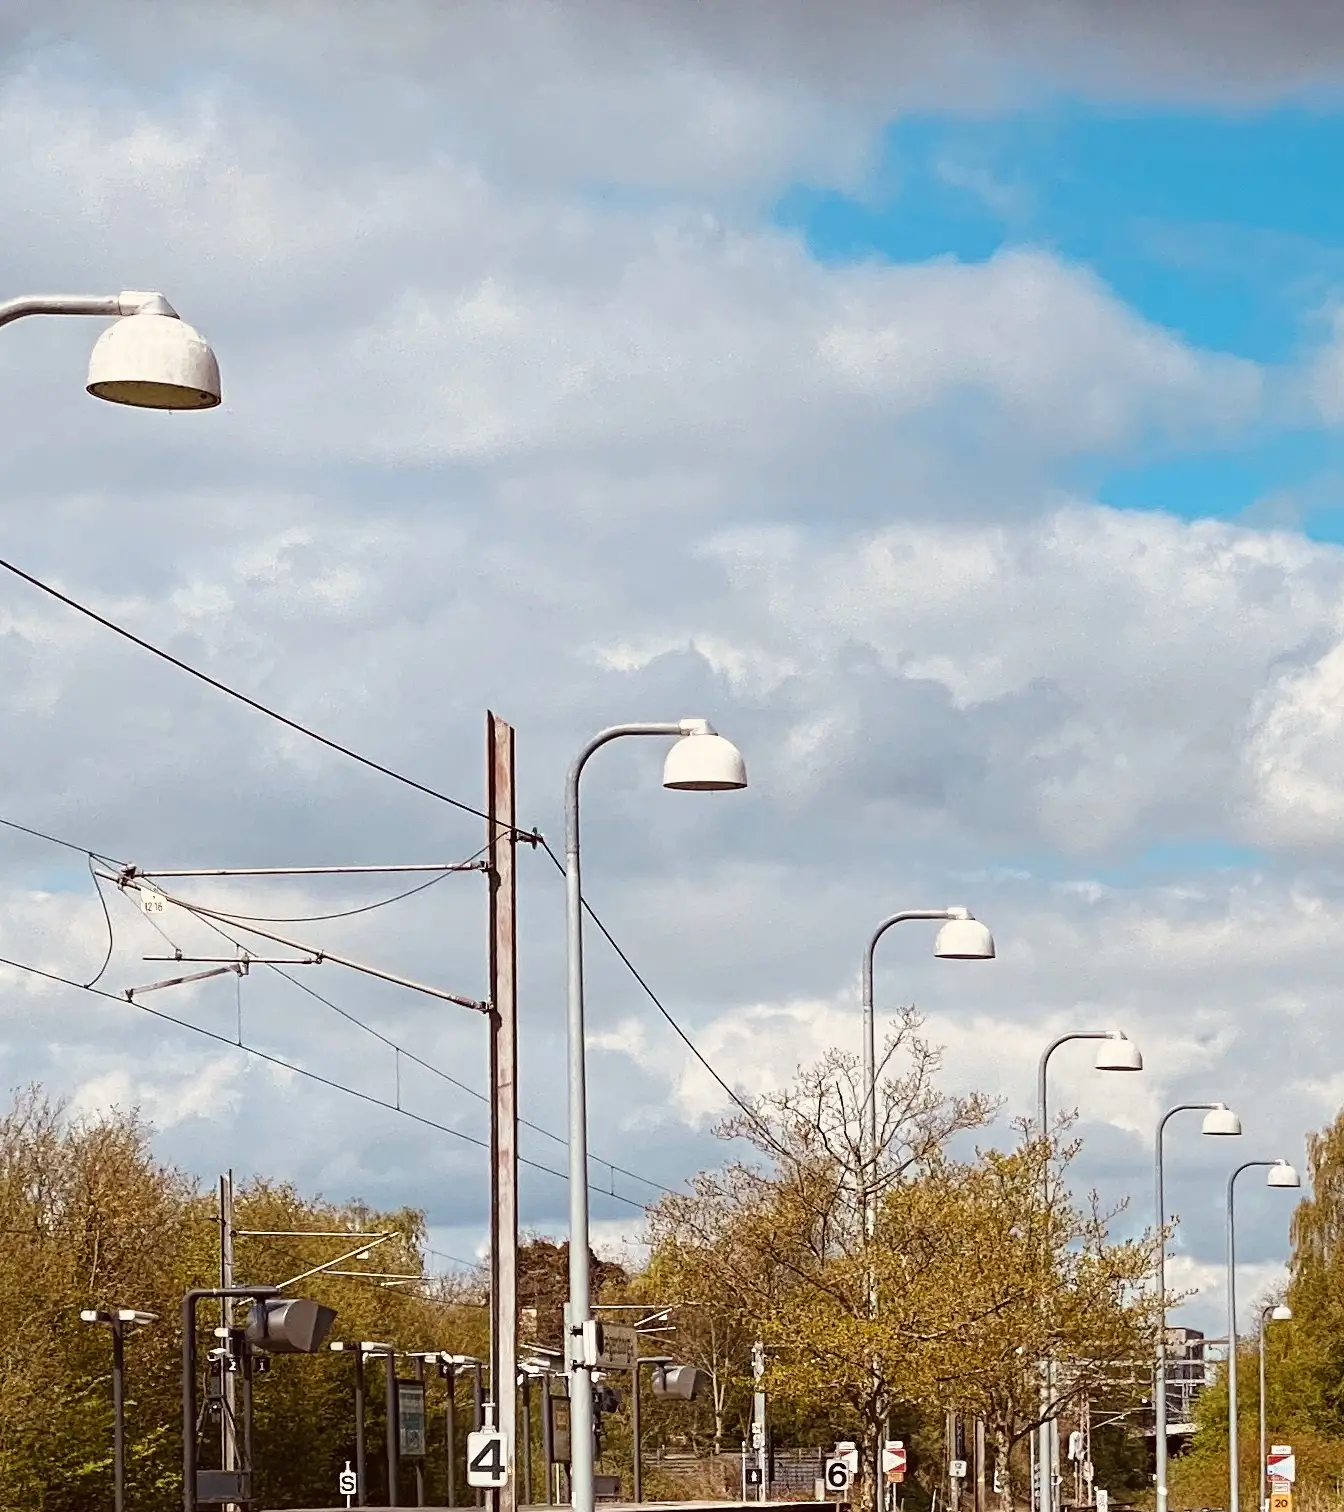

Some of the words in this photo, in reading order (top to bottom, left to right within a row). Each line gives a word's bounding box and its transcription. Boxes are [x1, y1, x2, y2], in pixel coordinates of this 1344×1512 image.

[470, 1439, 505, 1480] 4
[341, 1476, 354, 1491] S
[828, 1463, 847, 1487] 6
[1275, 1499, 1288, 1508] 20
